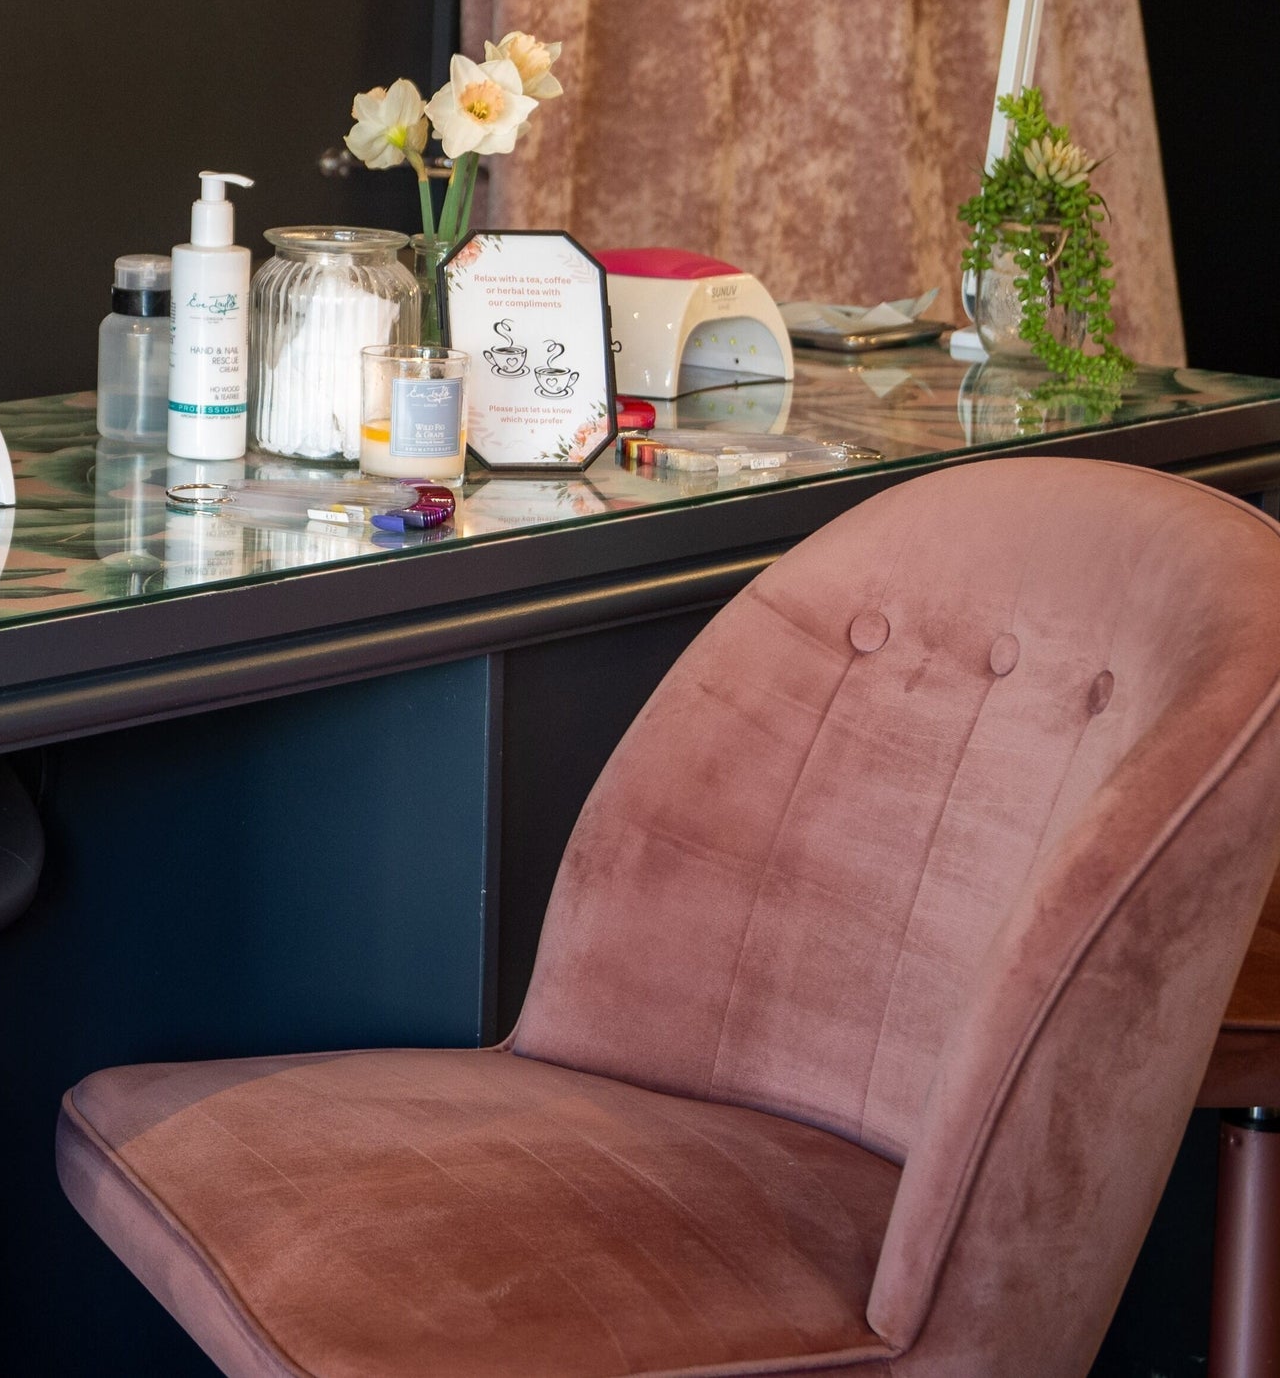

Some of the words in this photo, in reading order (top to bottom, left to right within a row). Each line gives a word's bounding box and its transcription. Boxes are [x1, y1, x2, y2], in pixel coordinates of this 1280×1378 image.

[474, 274, 497, 282] Relax
[499, 274, 517, 283] with
[526, 276, 542, 284] tea,
[544, 276, 572, 284] coffee
[498, 286, 524, 295] herbal
[527, 288, 540, 296] tea
[542, 288, 560, 296] with
[712, 286, 737, 298] SUNUV
[506, 300, 562, 309] compliments
[190, 346, 214, 354] HAND
[225, 346, 239, 354] NAIL
[212, 357, 239, 365] RESCUE
